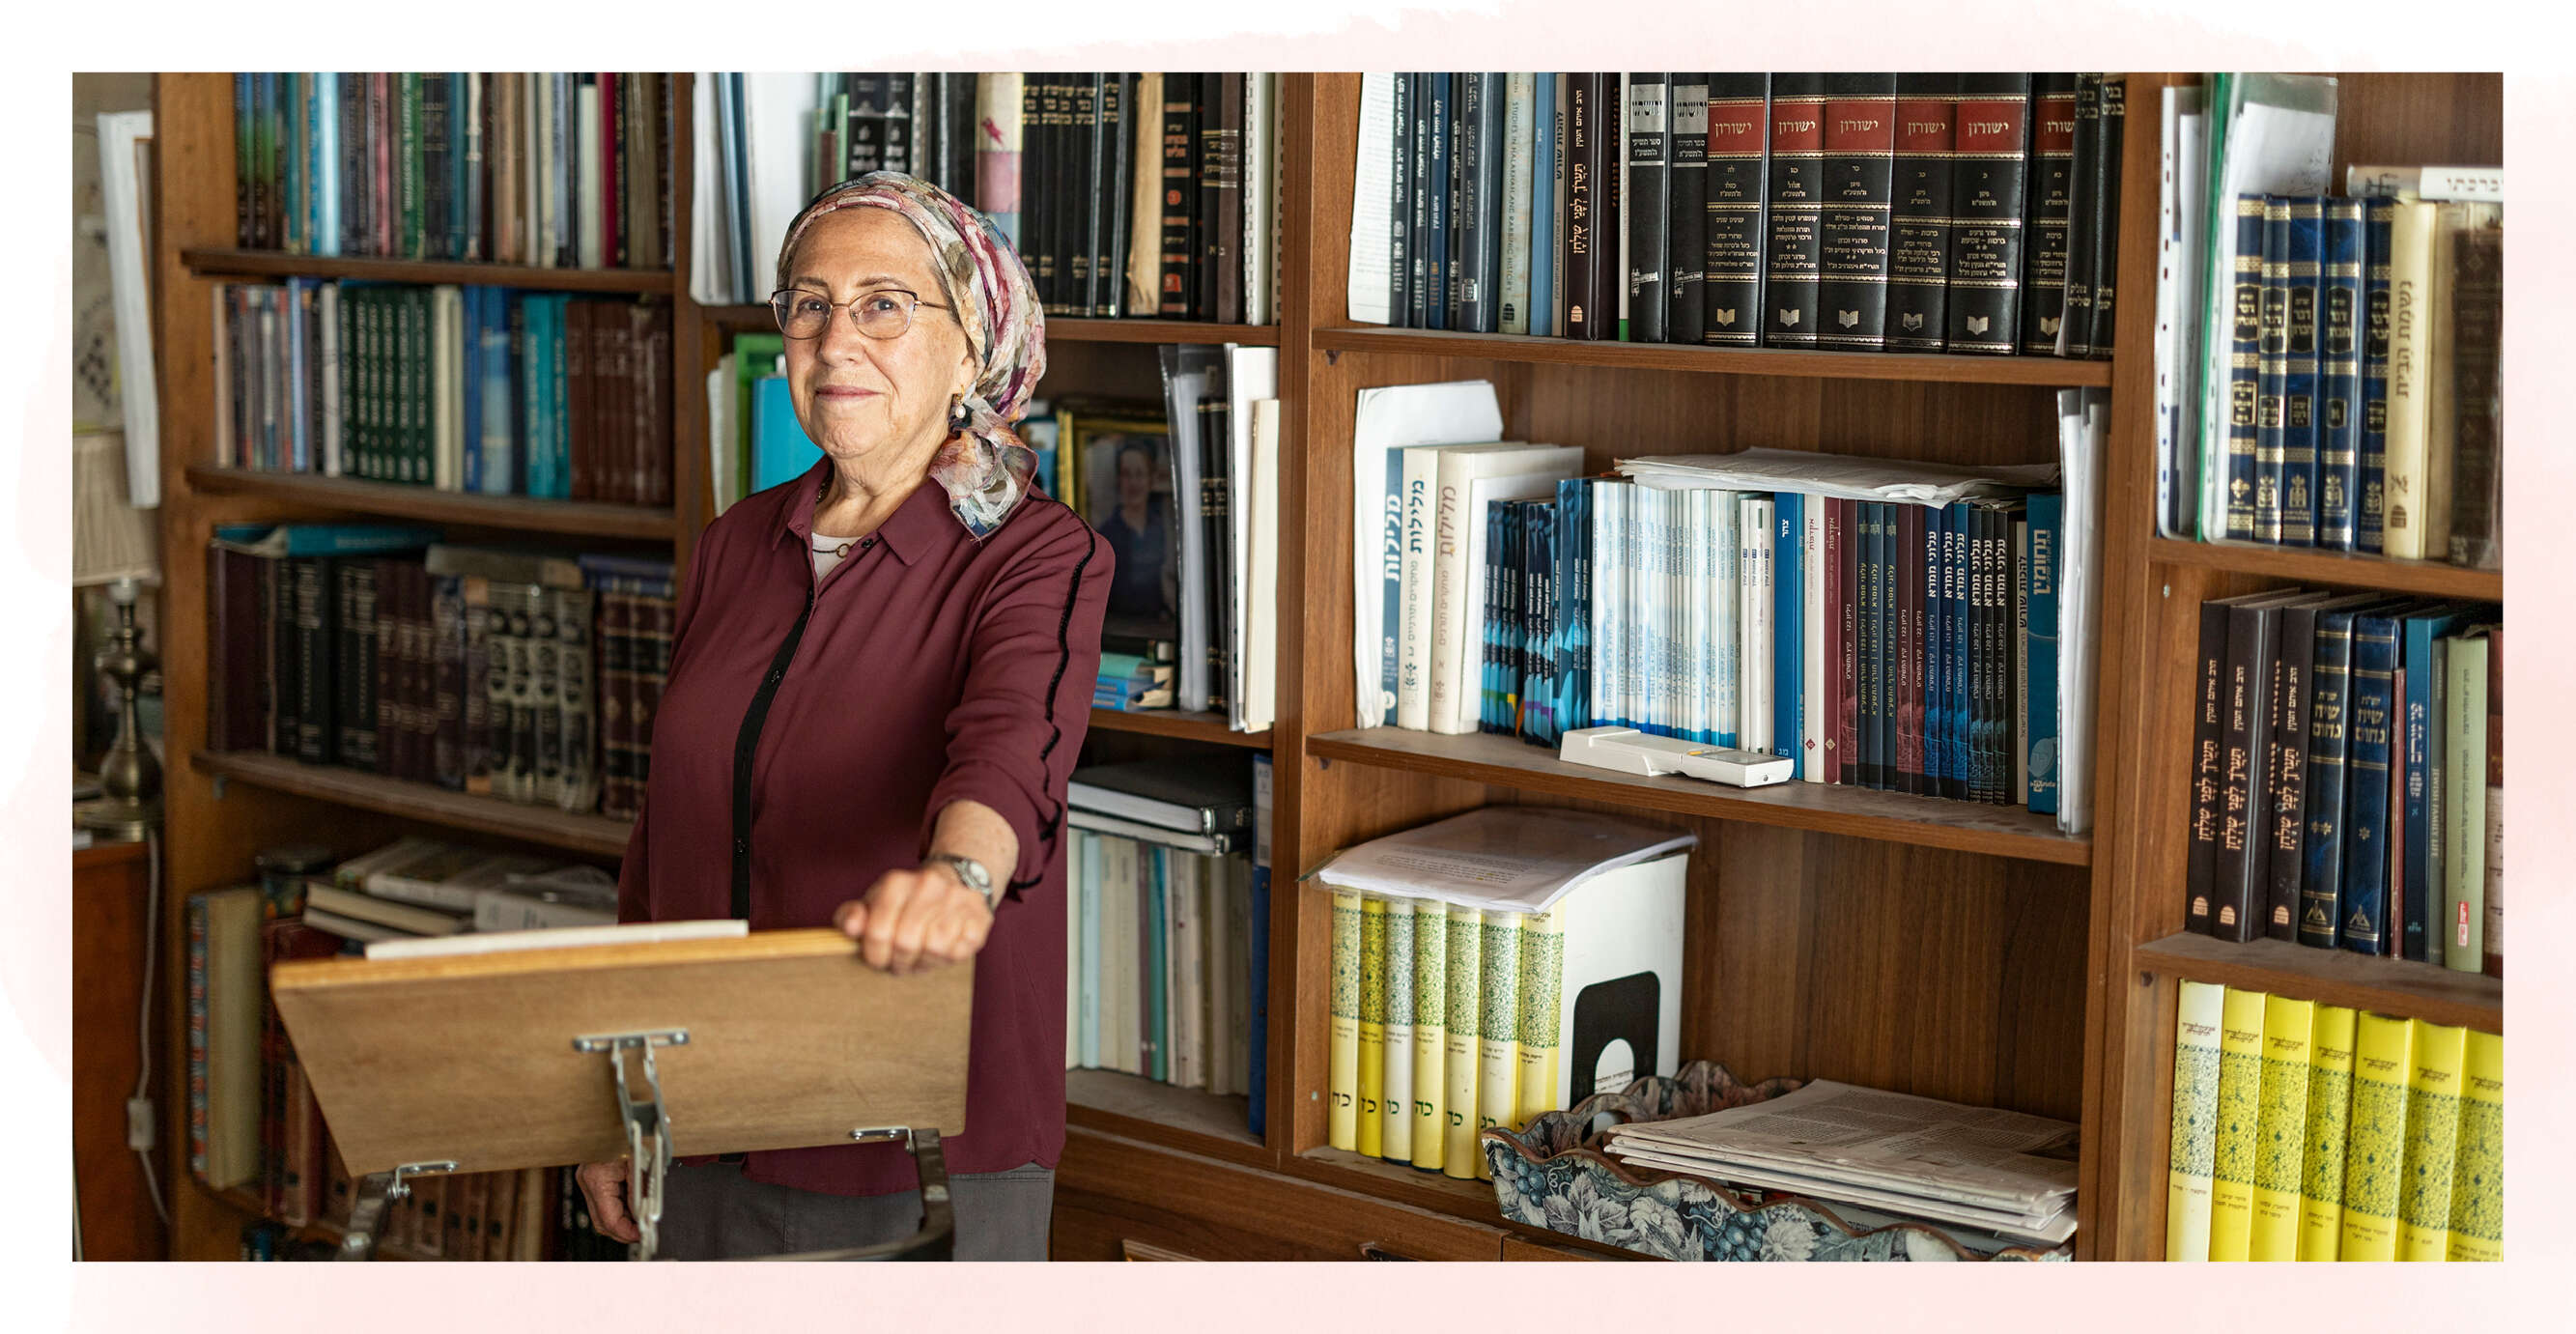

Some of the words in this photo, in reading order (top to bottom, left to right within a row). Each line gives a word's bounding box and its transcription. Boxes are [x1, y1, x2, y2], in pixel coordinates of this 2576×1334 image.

[2105, 86, 2121, 99] בני
[2103, 103, 2125, 116] בנים
[1715, 122, 1752, 138] ישורון
[1778, 121, 1816, 137] ישורון
[1840, 120, 1879, 134] ישורון
[1908, 122, 1945, 136] ישורון
[1968, 122, 2009, 137] ישורון
[1512, 135, 1517, 145] IN
[1406, 480, 1424, 554] מלילות
[1437, 486, 1457, 557] מלילות
[1384, 495, 1401, 582] מלילות
[1781, 519, 1790, 538] צהר
[1926, 531, 1938, 561] עלוני
[1943, 531, 1953, 562] עלוני
[1955, 533, 1966, 564] עלוני
[1970, 539, 1981, 570] עלוני
[1983, 539, 1993, 570] עלוני
[1996, 539, 2005, 570] עלוני
[2032, 529, 2052, 595] תחומין
[1408, 560, 1418, 602] מחקרים
[1926, 566, 1938, 598] ממרא
[1943, 566, 1953, 599] ממרא
[1955, 568, 1966, 600] ממרא
[2017, 555, 2028, 592] להכות
[1439, 570, 1449, 610] מחקרים
[1970, 574, 1981, 607] ממרא
[1983, 575, 1993, 607] ממרא
[1996, 574, 2005, 607] ממרא
[2208, 659, 2217, 676] הרב
[2207, 678, 2216, 700] איתם
[2235, 686, 2244, 707] איתם
[2288, 686, 2297, 707] איתם
[2205, 703, 2215, 723] הנקין
[2233, 710, 2244, 730] הנקין
[2287, 711, 2297, 730] הנקין
[2315, 703, 2339, 720] שיח
[2358, 708, 2383, 724] שיח
[2312, 722, 2341, 739] נחום
[2356, 726, 2386, 744] נחום
[2431, 804, 2440, 837] FAMILY
[1361, 1097, 1376, 1113] כז
[1387, 1099, 1400, 1115] כו
[1415, 1100, 1433, 1117] כה
[1447, 1111, 1463, 1126] כד
